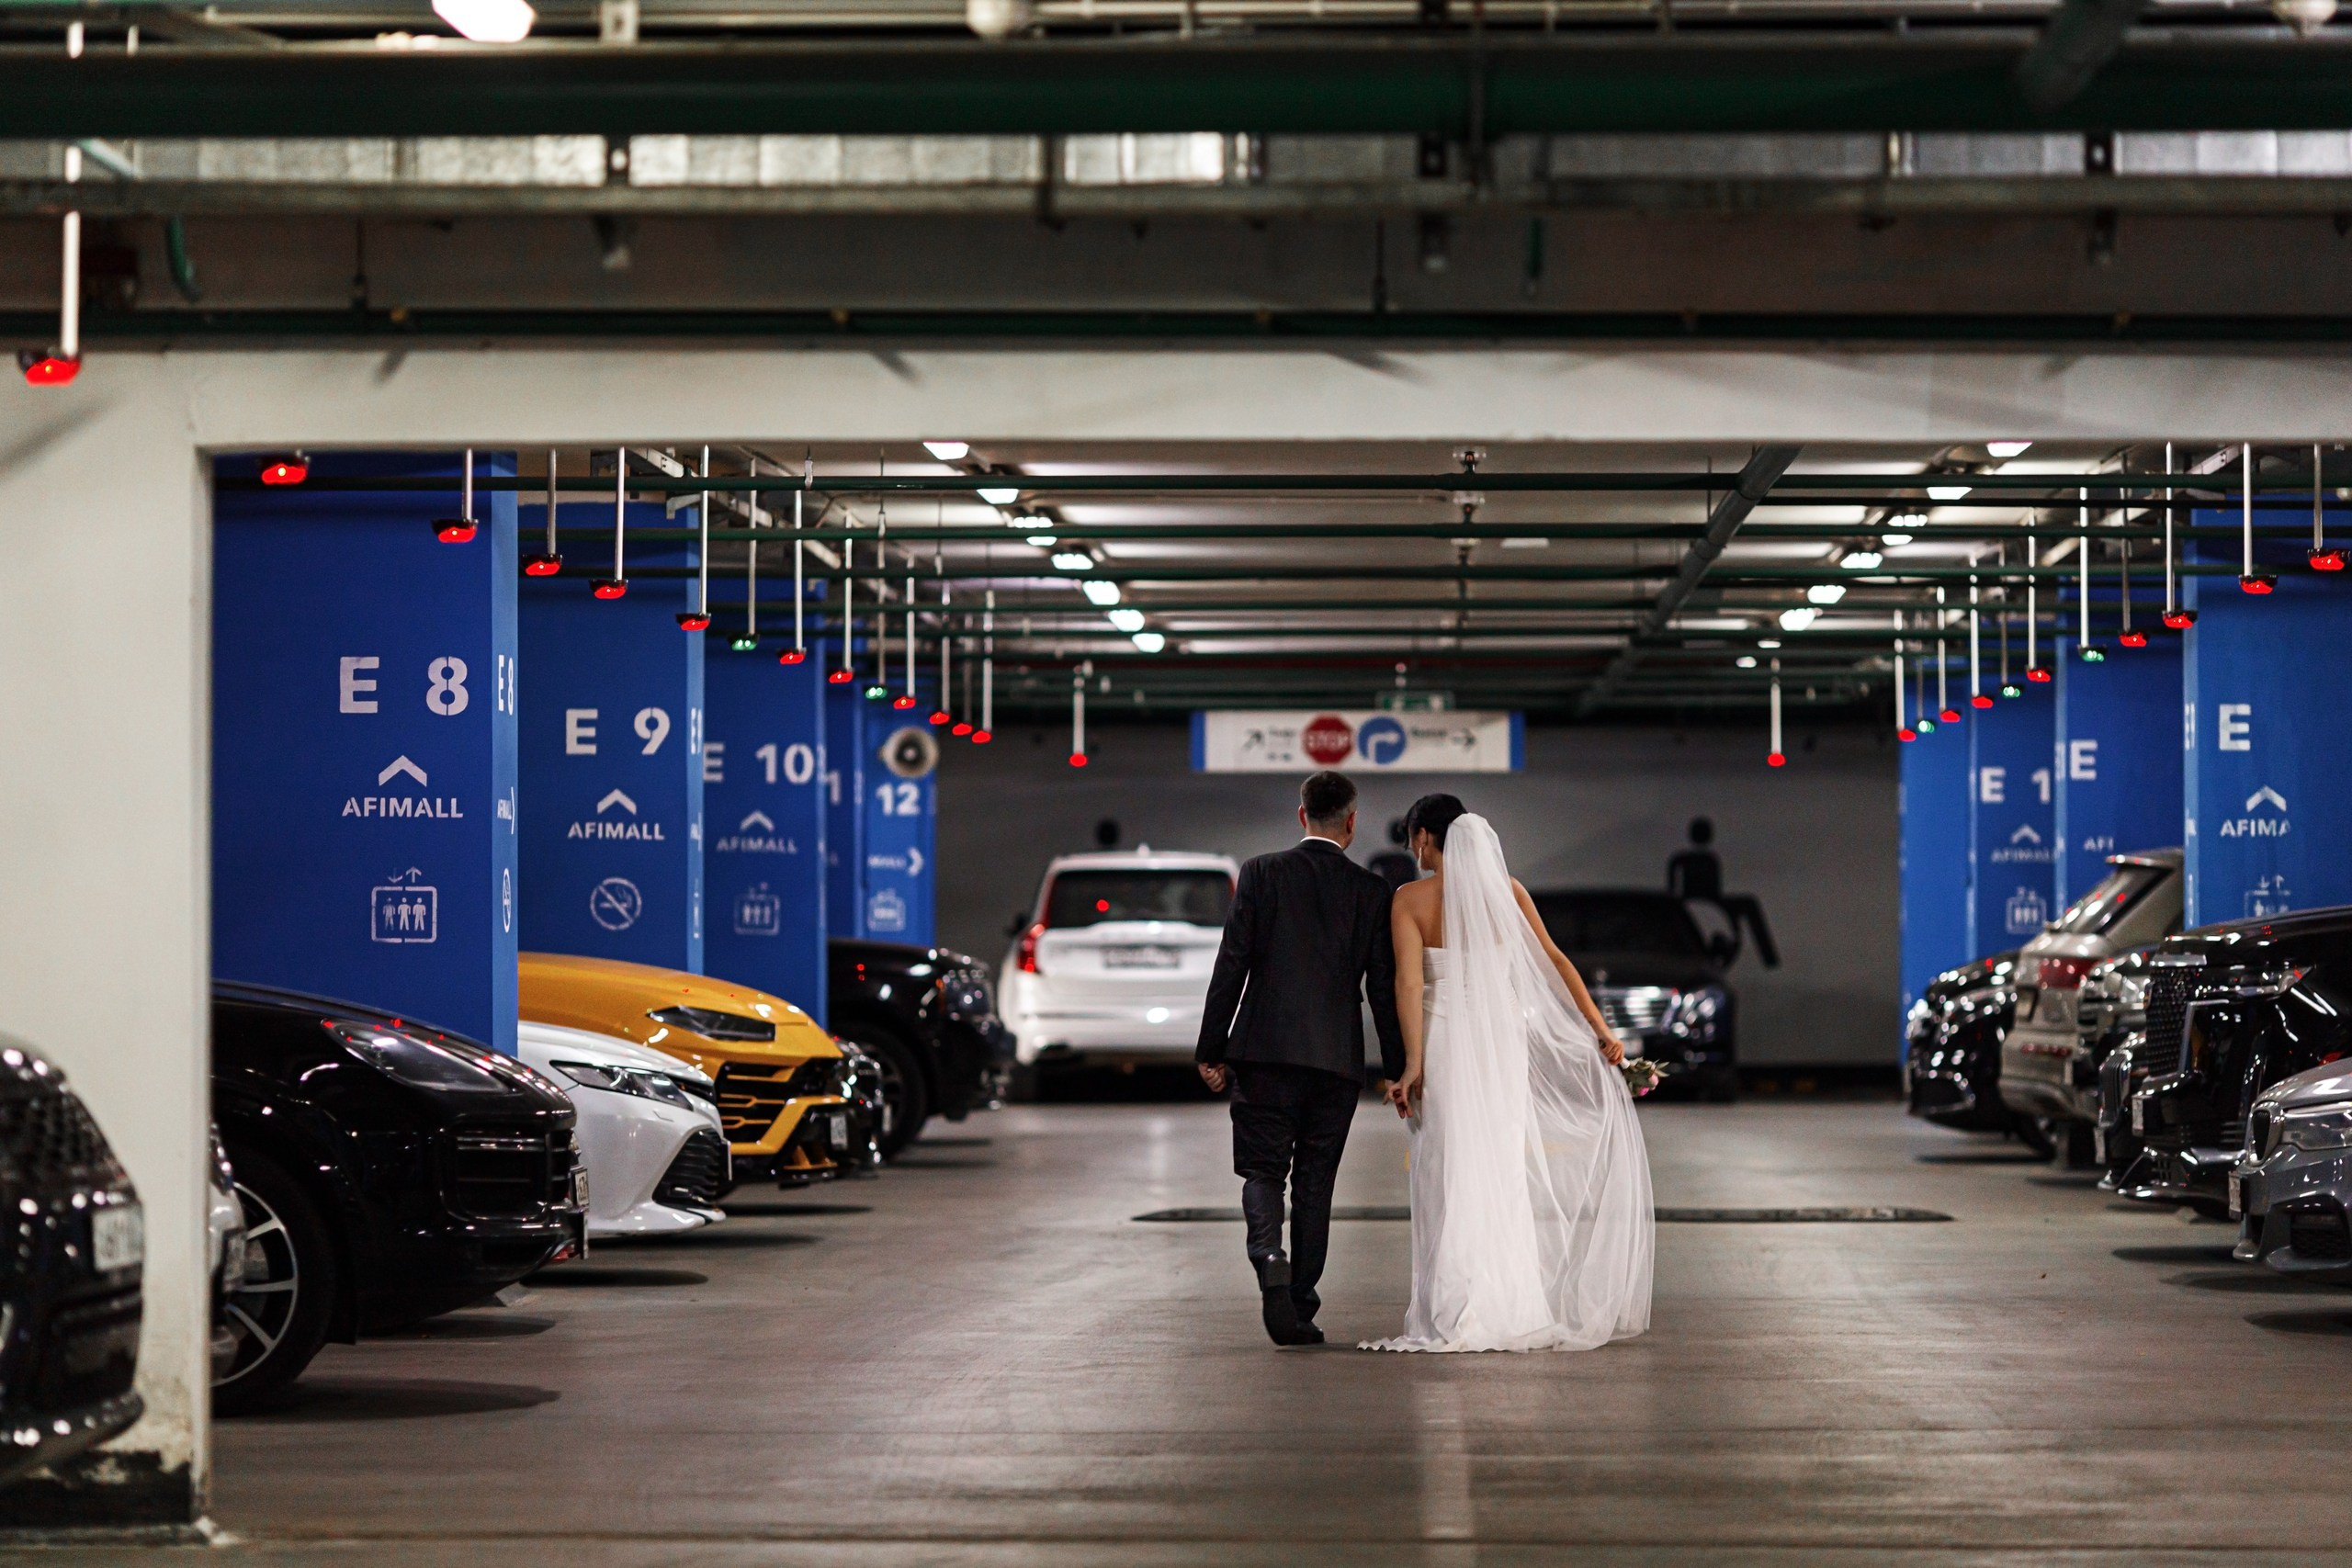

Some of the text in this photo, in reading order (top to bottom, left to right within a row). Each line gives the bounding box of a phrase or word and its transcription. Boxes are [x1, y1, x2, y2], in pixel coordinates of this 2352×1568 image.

[339, 656, 469, 716] E 8
[565, 708, 599, 755] E
[633, 706, 671, 755] 9
[2218, 703, 2252, 751] E
[703, 742, 814, 784] E 10
[2069, 739, 2098, 781] E
[876, 783, 920, 816] 12
[1979, 766, 2006, 804] E
[342, 796, 464, 818] AFIMALL
[568, 821, 665, 840] AFIMALL
[717, 836, 797, 854] AFIMALL
